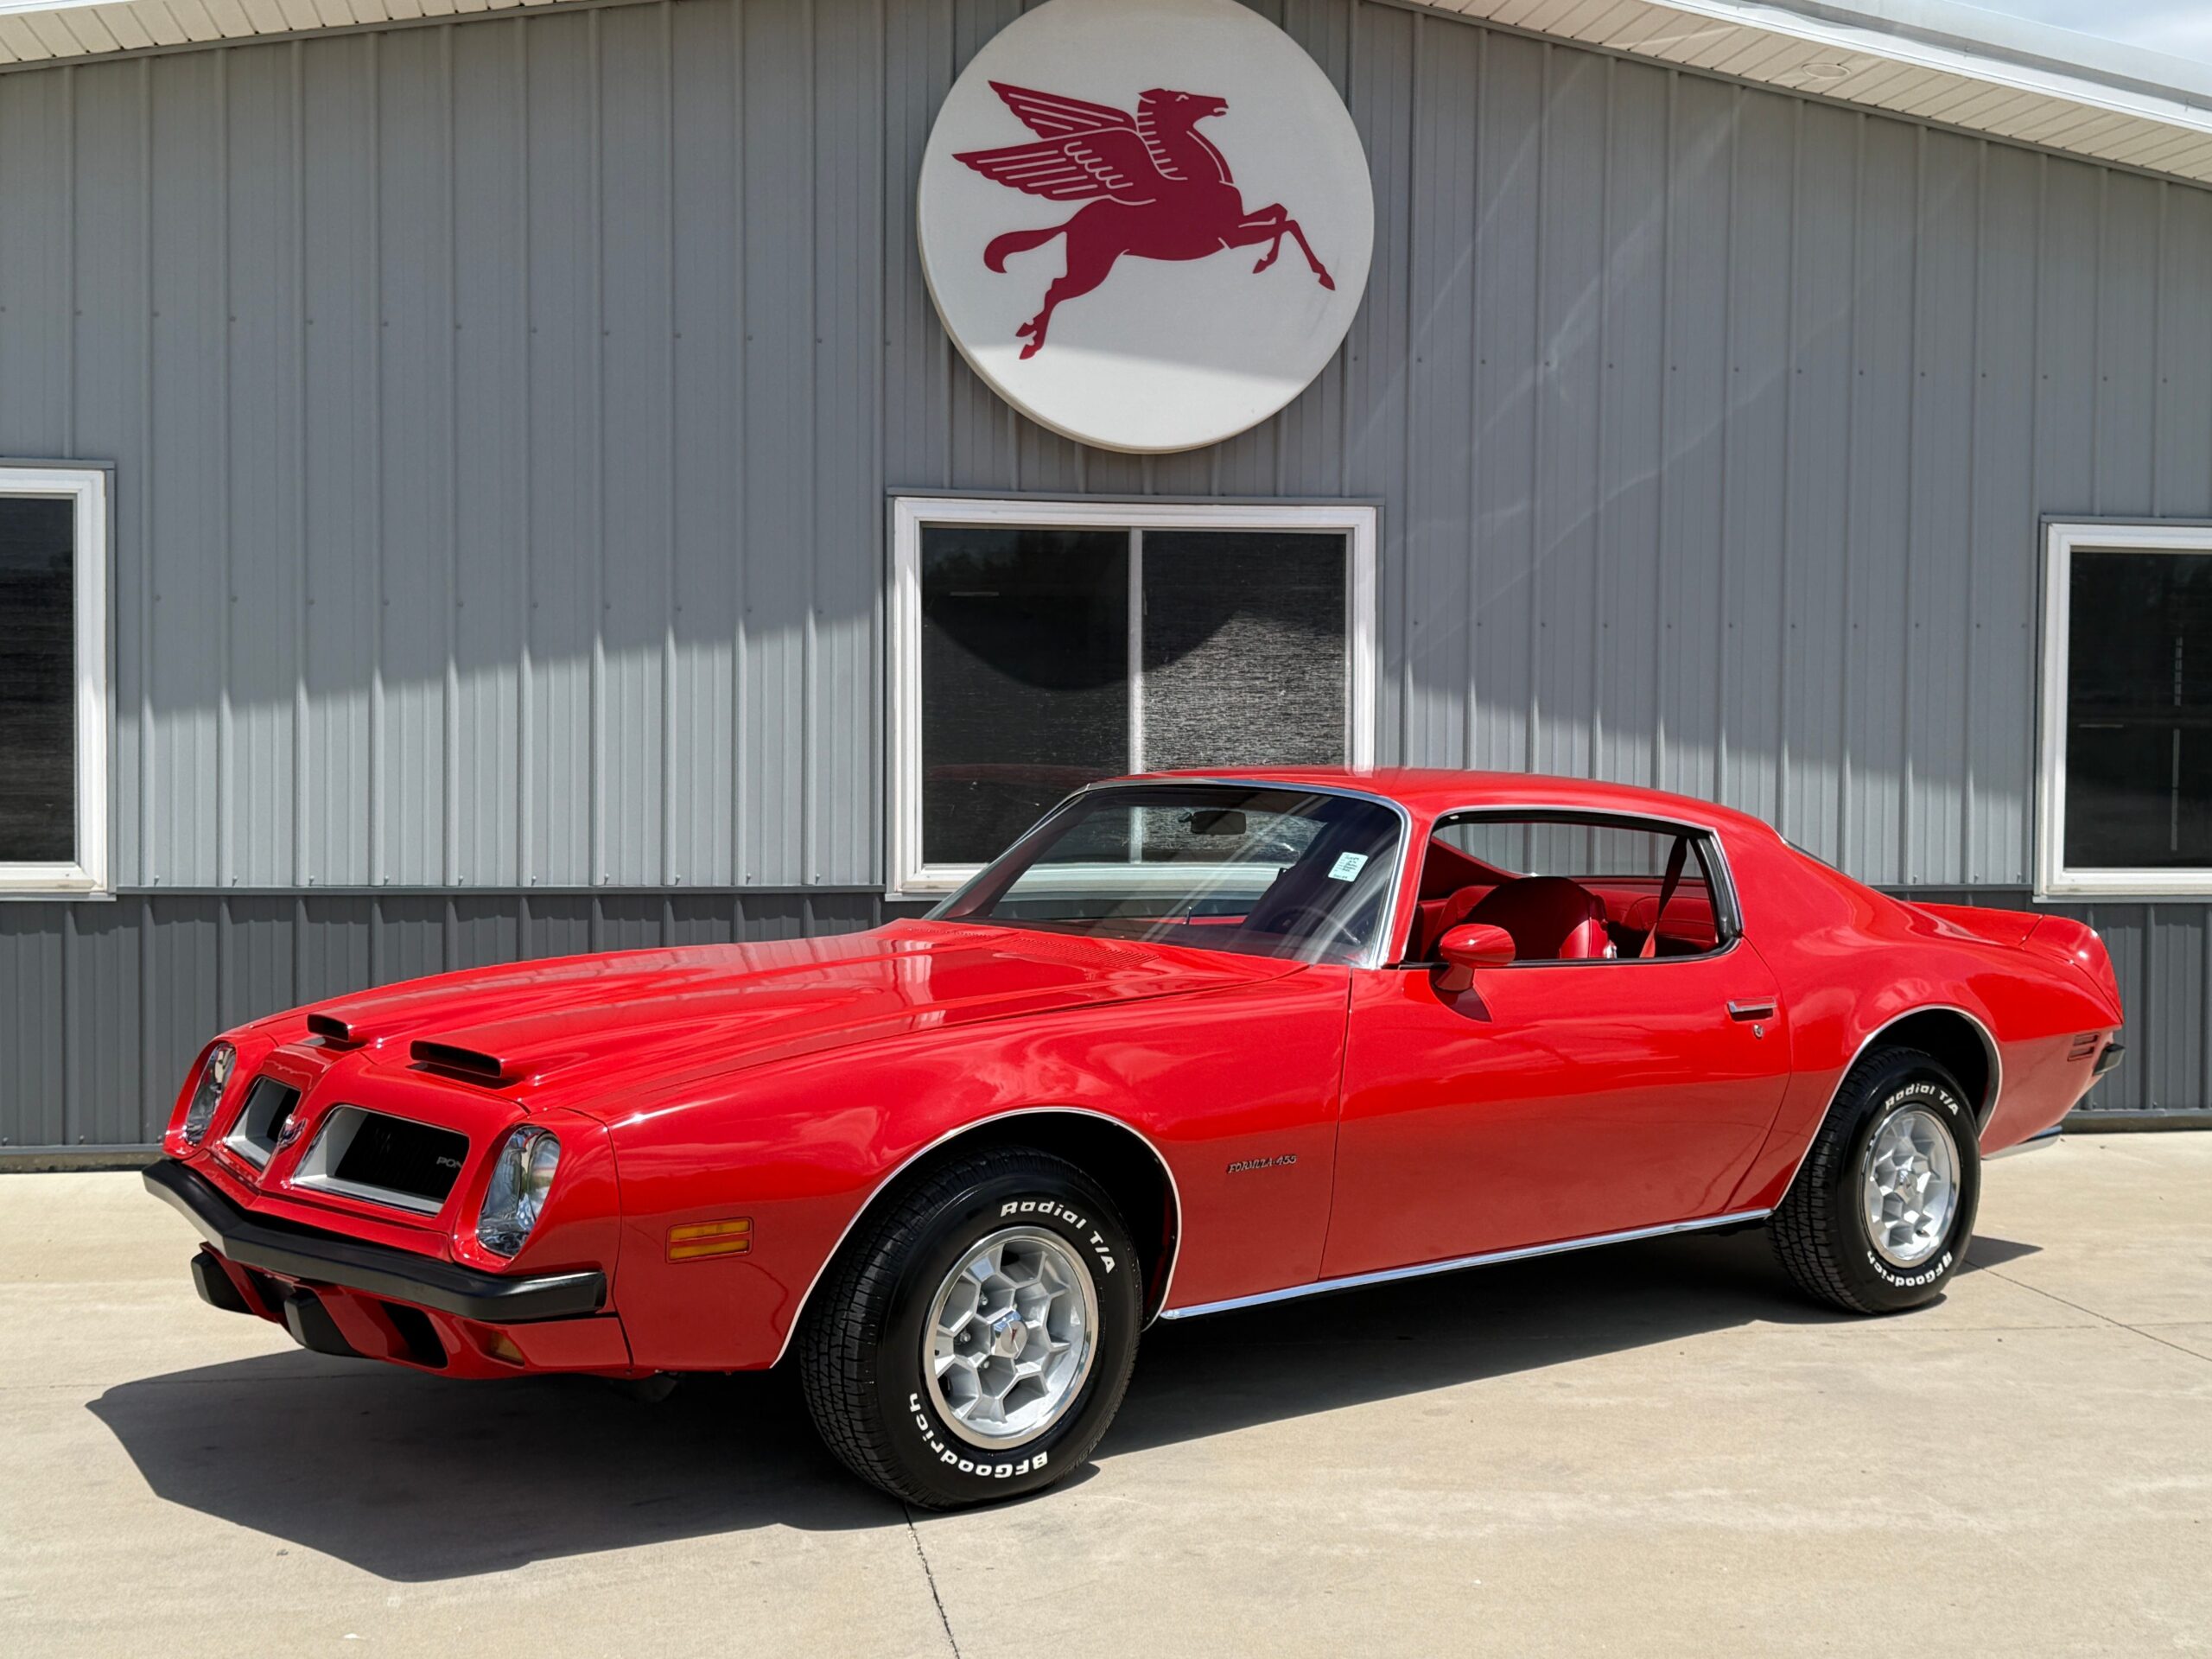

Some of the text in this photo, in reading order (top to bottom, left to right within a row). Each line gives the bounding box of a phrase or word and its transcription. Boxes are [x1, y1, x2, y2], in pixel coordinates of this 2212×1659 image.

[1885, 1083, 1960, 1116] Radial T/A
[1000, 1200, 1116, 1274] Radial T/A
[1867, 1251, 1953, 1287] BFGoodrich
[909, 1392, 1048, 1478] BFGoodrich
